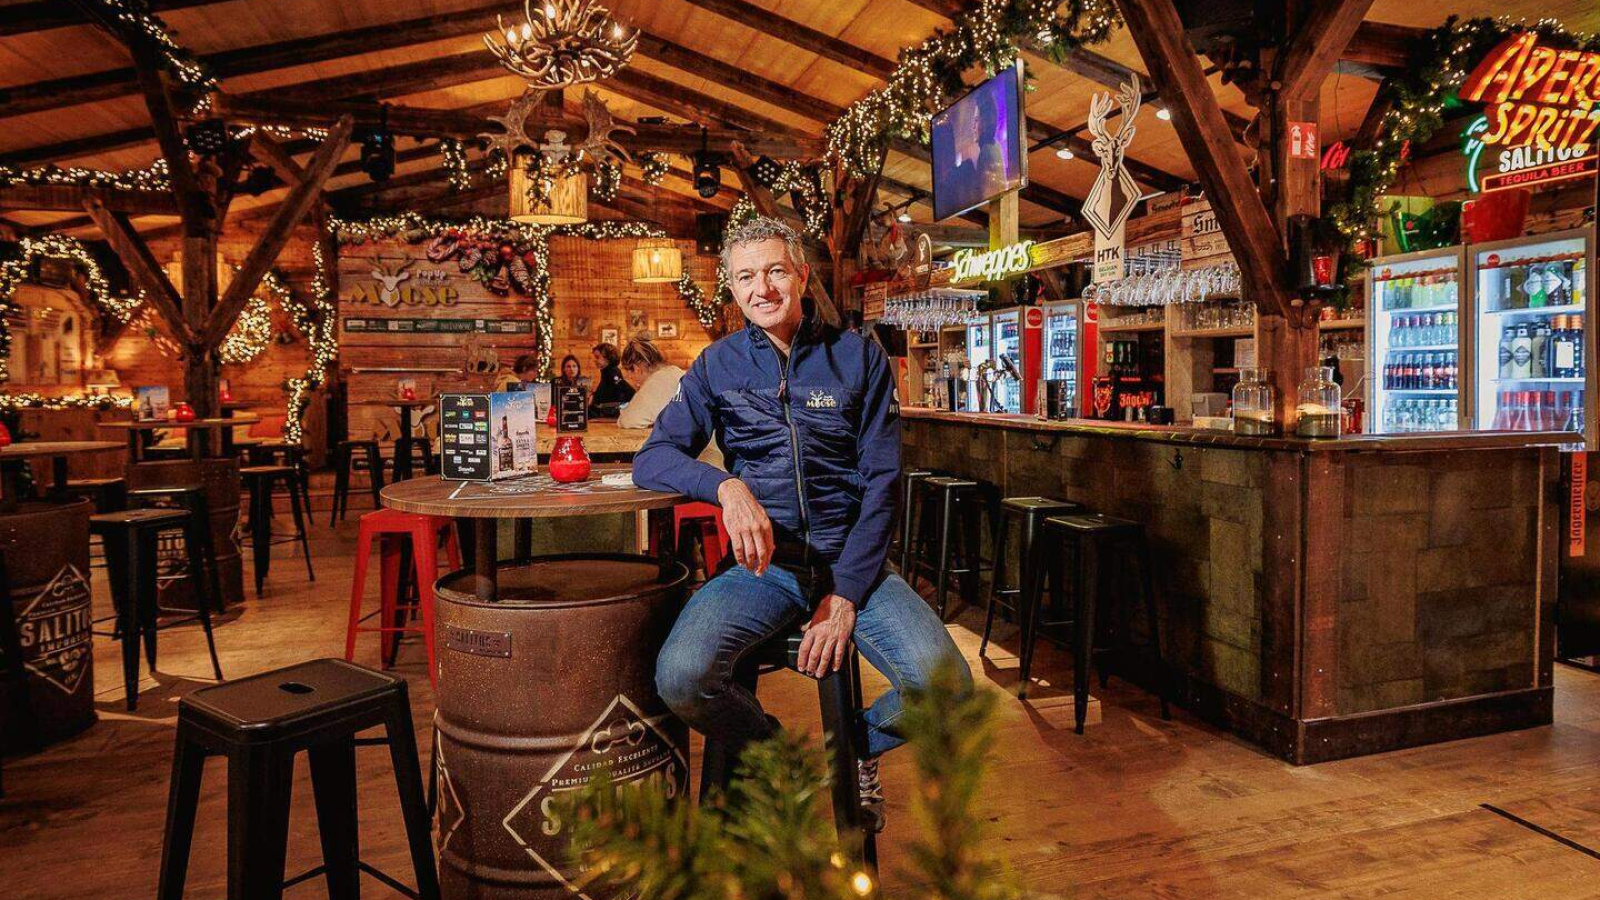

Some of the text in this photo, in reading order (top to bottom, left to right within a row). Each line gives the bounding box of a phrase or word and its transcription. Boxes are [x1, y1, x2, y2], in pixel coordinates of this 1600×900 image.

[1500, 162, 1585, 186] TEQUILA BEER
[949, 240, 1035, 284] Schweppes
[1097, 246, 1120, 263] HTK
[573, 758, 614, 773] CALIDAD
